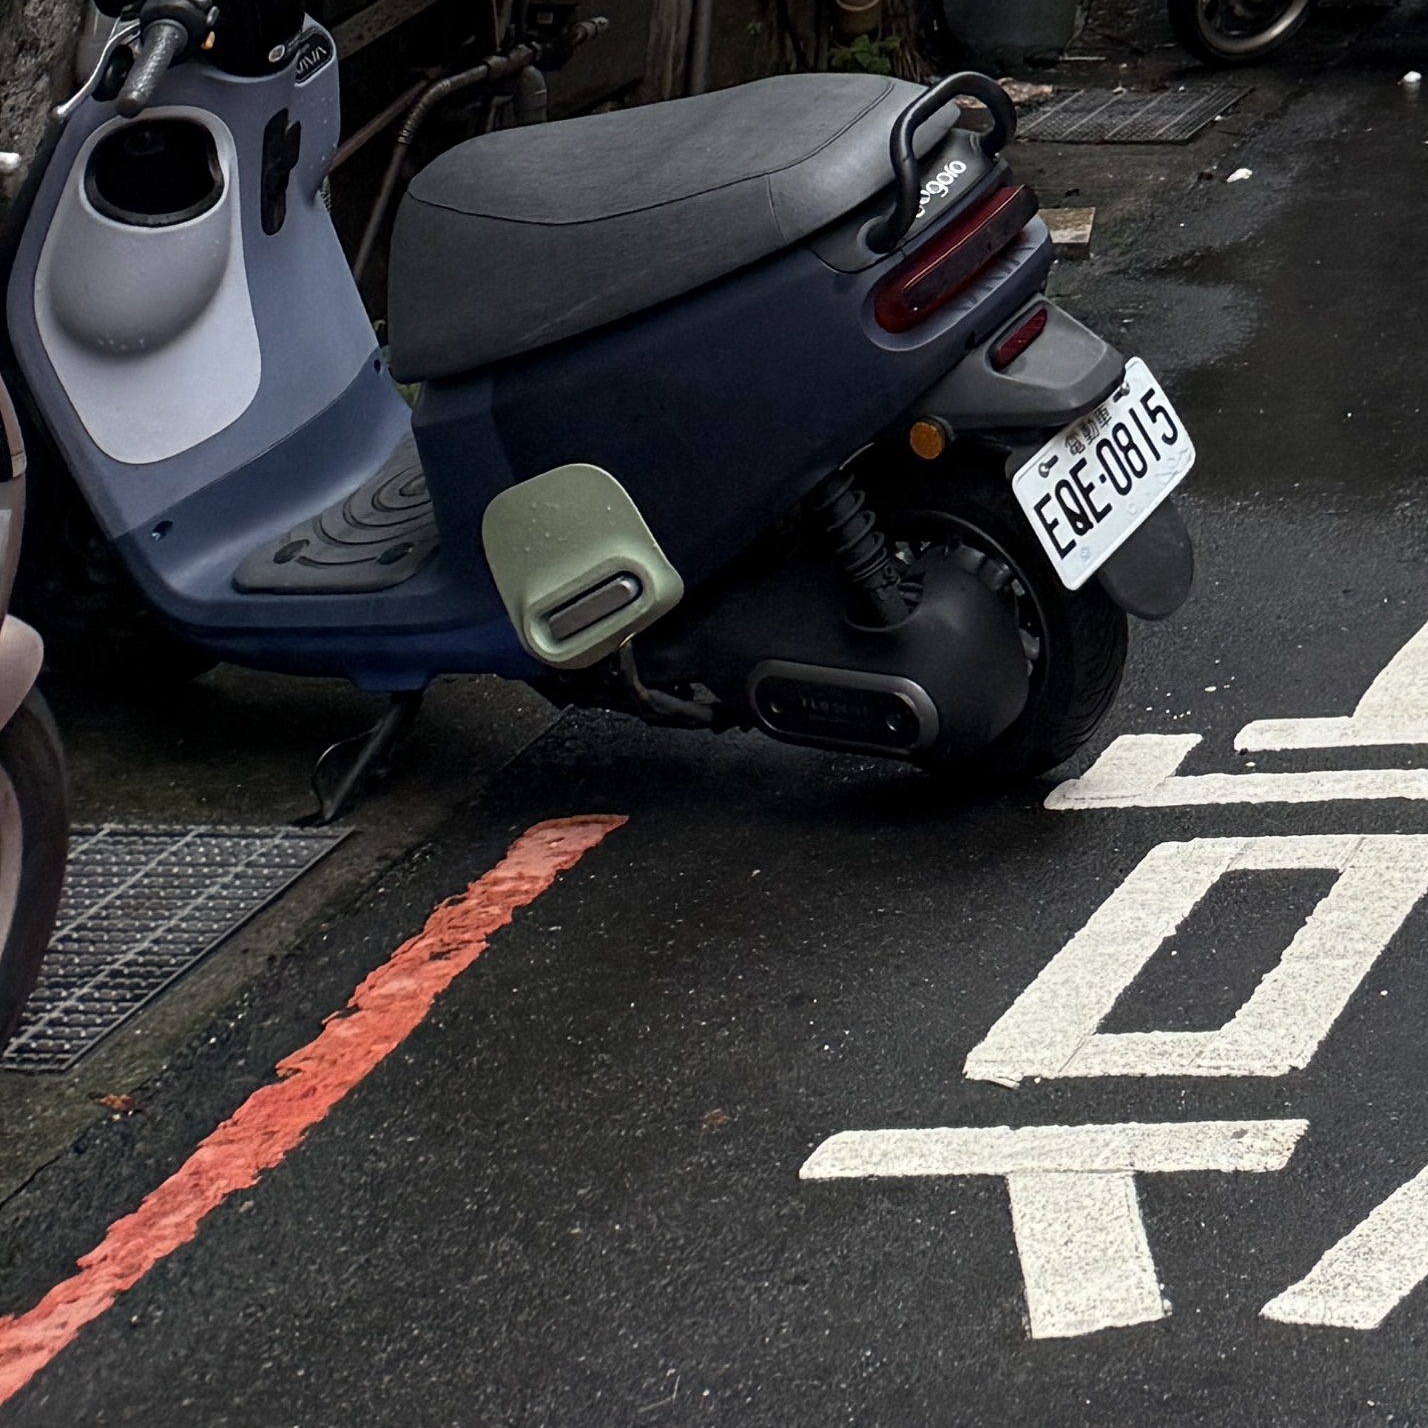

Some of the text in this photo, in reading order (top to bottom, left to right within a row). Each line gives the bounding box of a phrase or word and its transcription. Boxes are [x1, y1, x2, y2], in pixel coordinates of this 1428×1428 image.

[1033, 388, 1179, 559] EQE-0815
[1065, 406, 1112, 456] 電動車
